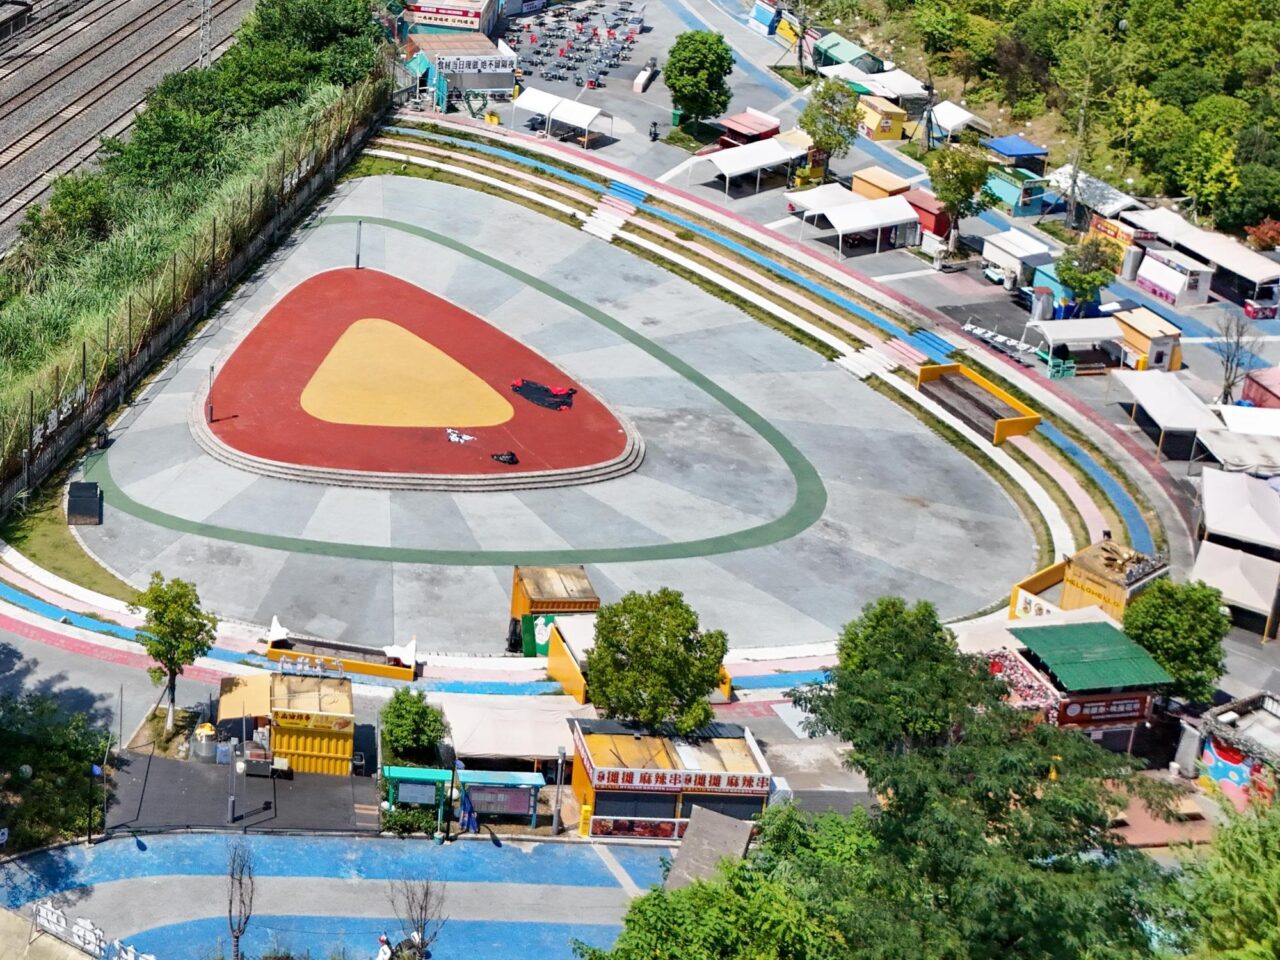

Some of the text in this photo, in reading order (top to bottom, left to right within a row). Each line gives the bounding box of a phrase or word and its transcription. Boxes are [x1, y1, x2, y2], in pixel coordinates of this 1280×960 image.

[639, 771, 682, 785] 麻辣串
[726, 775, 769, 788] 麻辣串
